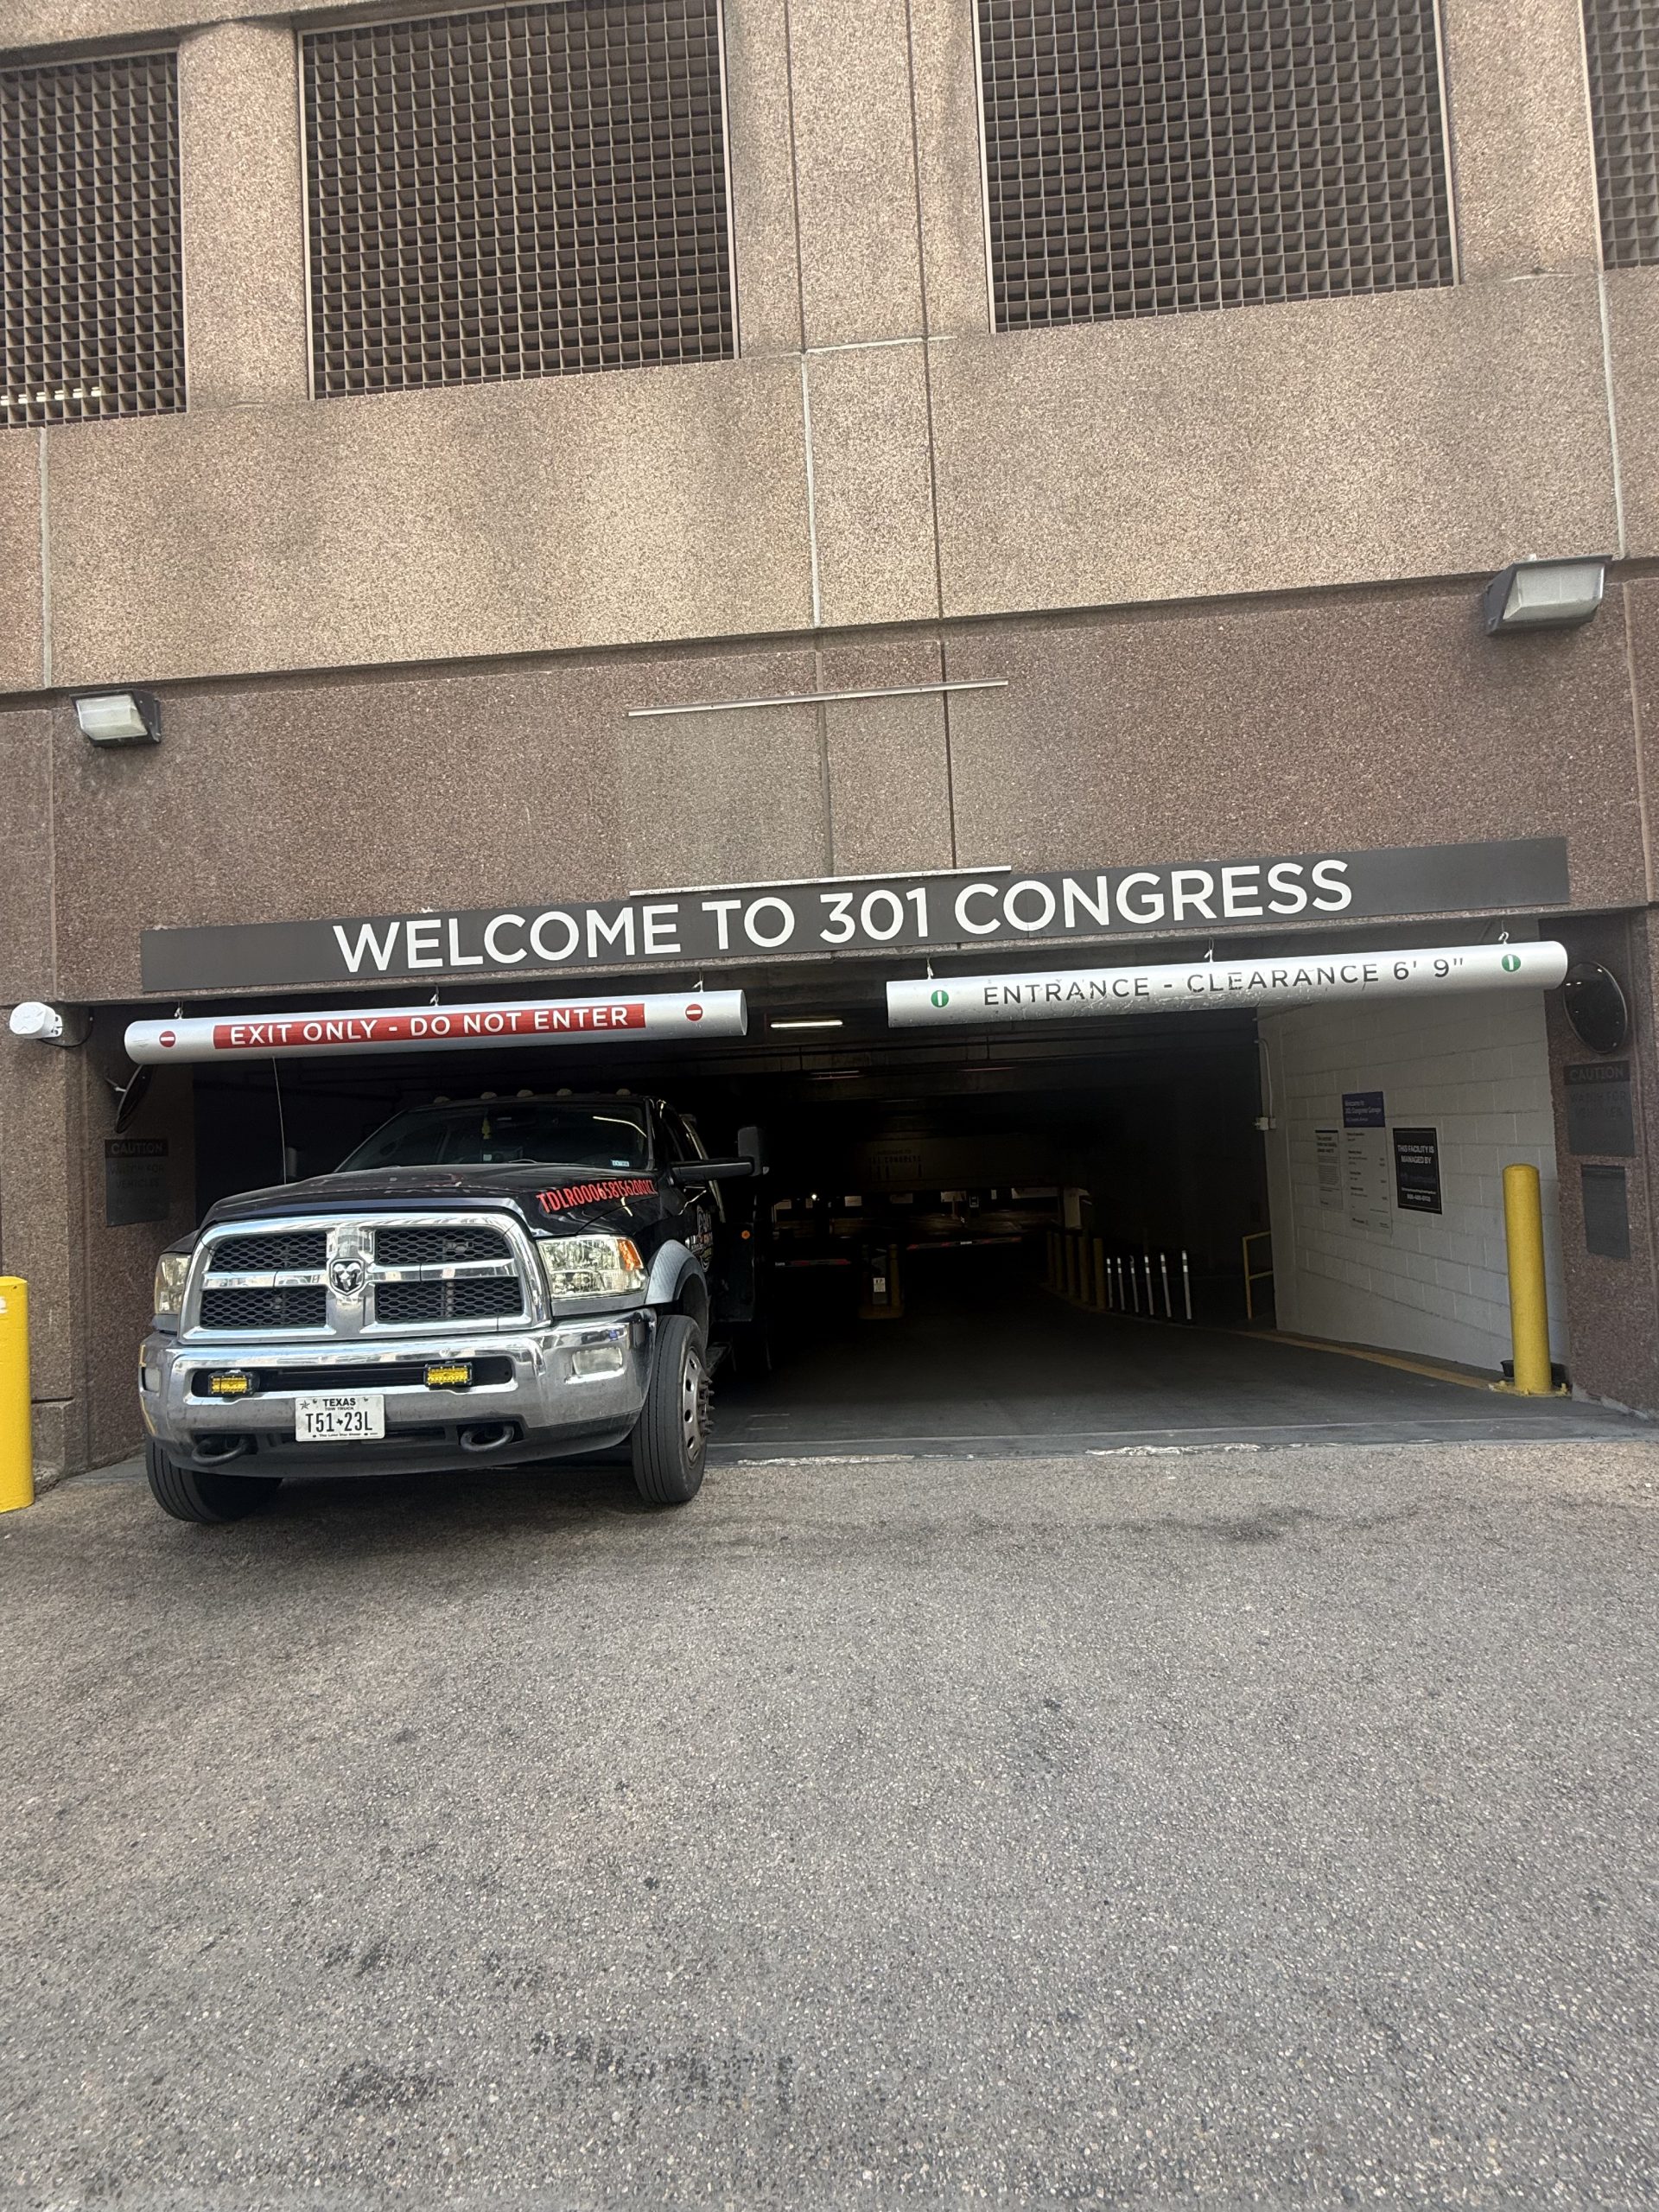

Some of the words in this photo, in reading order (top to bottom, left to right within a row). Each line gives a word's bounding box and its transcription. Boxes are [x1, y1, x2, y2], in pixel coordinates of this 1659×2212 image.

[333, 904, 682, 973] WELCOME
[701, 896, 796, 950] TO
[819, 887, 930, 944] 301
[954, 859, 1353, 935] CONGRESS
[984, 977, 1150, 1006] ENTRANCE
[1187, 963, 1380, 994] CLEARANCE
[1394, 961, 1418, 981] 6'
[1433, 957, 1465, 978] 9"
[230, 1024, 292, 1046] EXIT
[302, 1020, 378, 1042] ONLY
[410, 1016, 450, 1037] DO
[463, 1012, 522, 1033] NOT
[534, 1006, 629, 1031] ENTER
[1569, 1065, 1624, 1081] CAUTION
[111, 1142, 163, 1155] CAUTION
[1397, 1144, 1408, 1153] THIS
[1408, 1145, 1429, 1154] FACILITY
[1401, 1155, 1424, 1164] MANAGED
[117, 1177, 160, 1190] VEHICLES
[322, 1397, 356, 1408] TEXAS
[305, 1413, 334, 1433] T51
[344, 1411, 373, 1432] 23L
